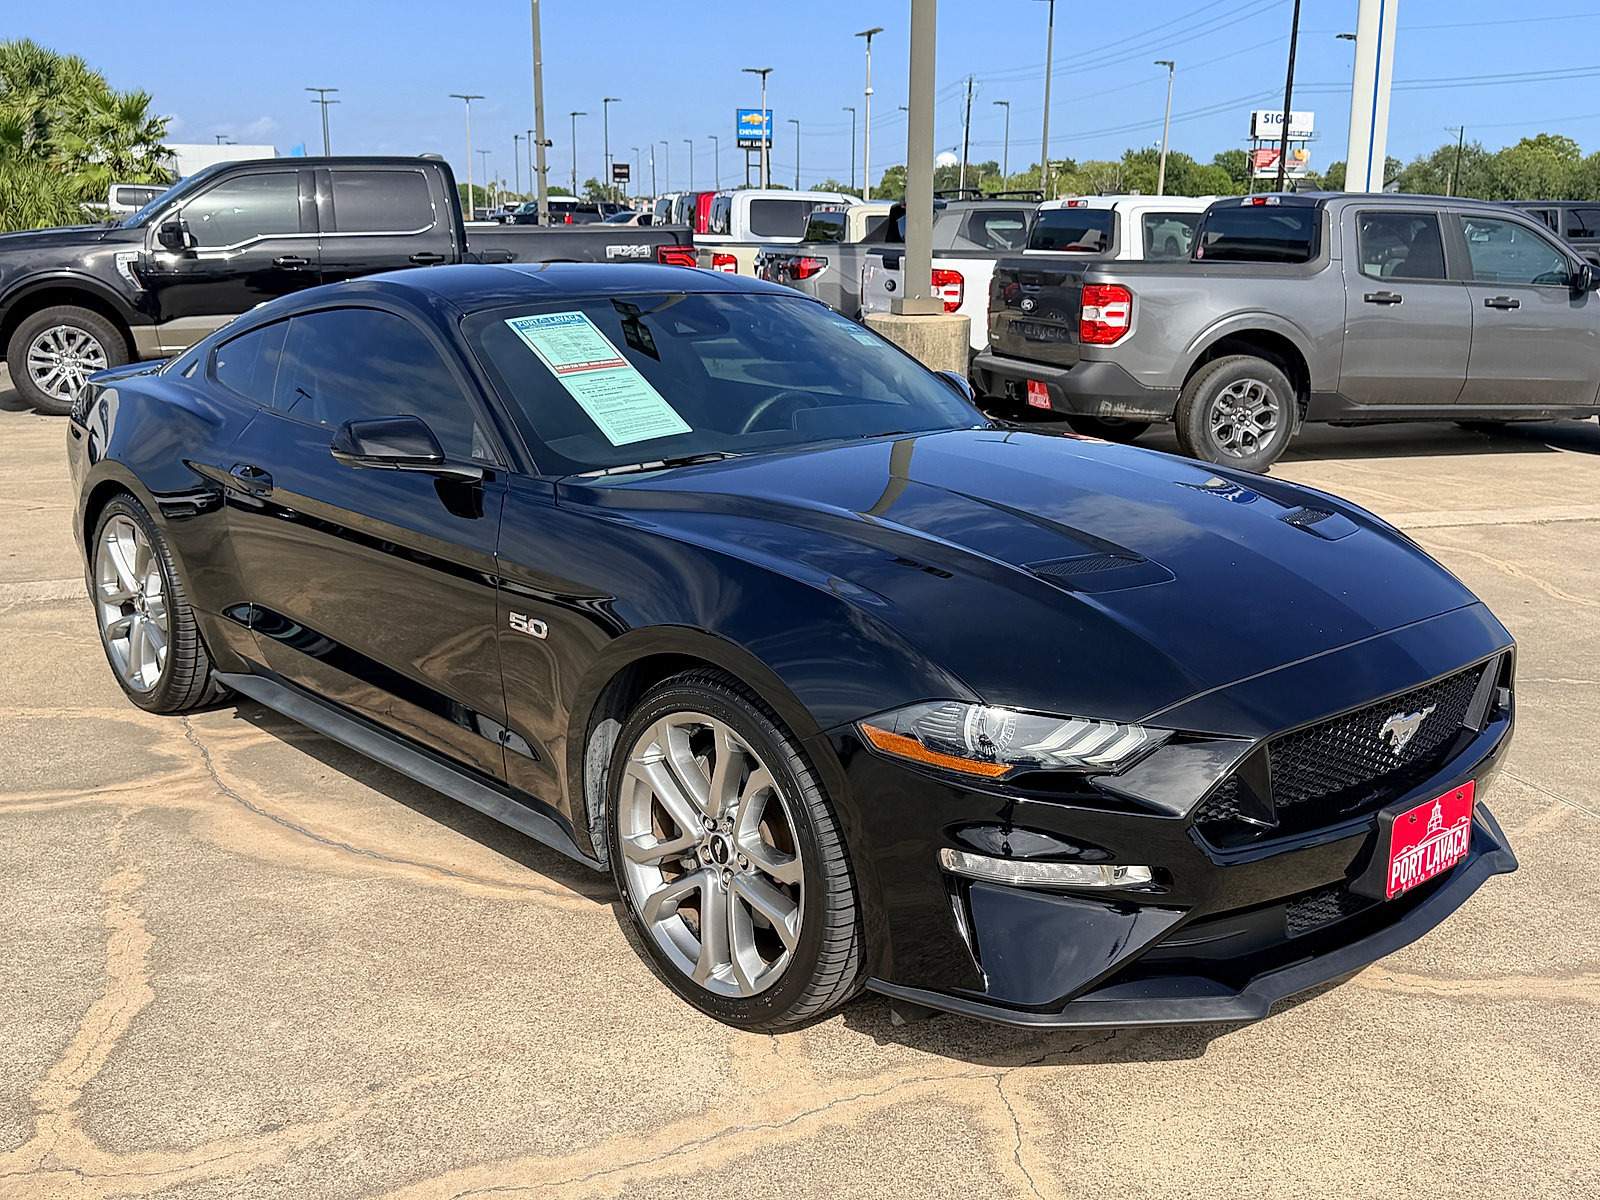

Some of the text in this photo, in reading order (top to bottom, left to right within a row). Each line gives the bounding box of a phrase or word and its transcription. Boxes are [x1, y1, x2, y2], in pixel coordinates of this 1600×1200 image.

[605, 244, 652, 259] FX4
[516, 318, 540, 328] PORT
[548, 314, 582, 323] LAVACA
[1390, 825, 1467, 889] PORT LAVACA
[1402, 855, 1459, 891] AUTO GROUP
